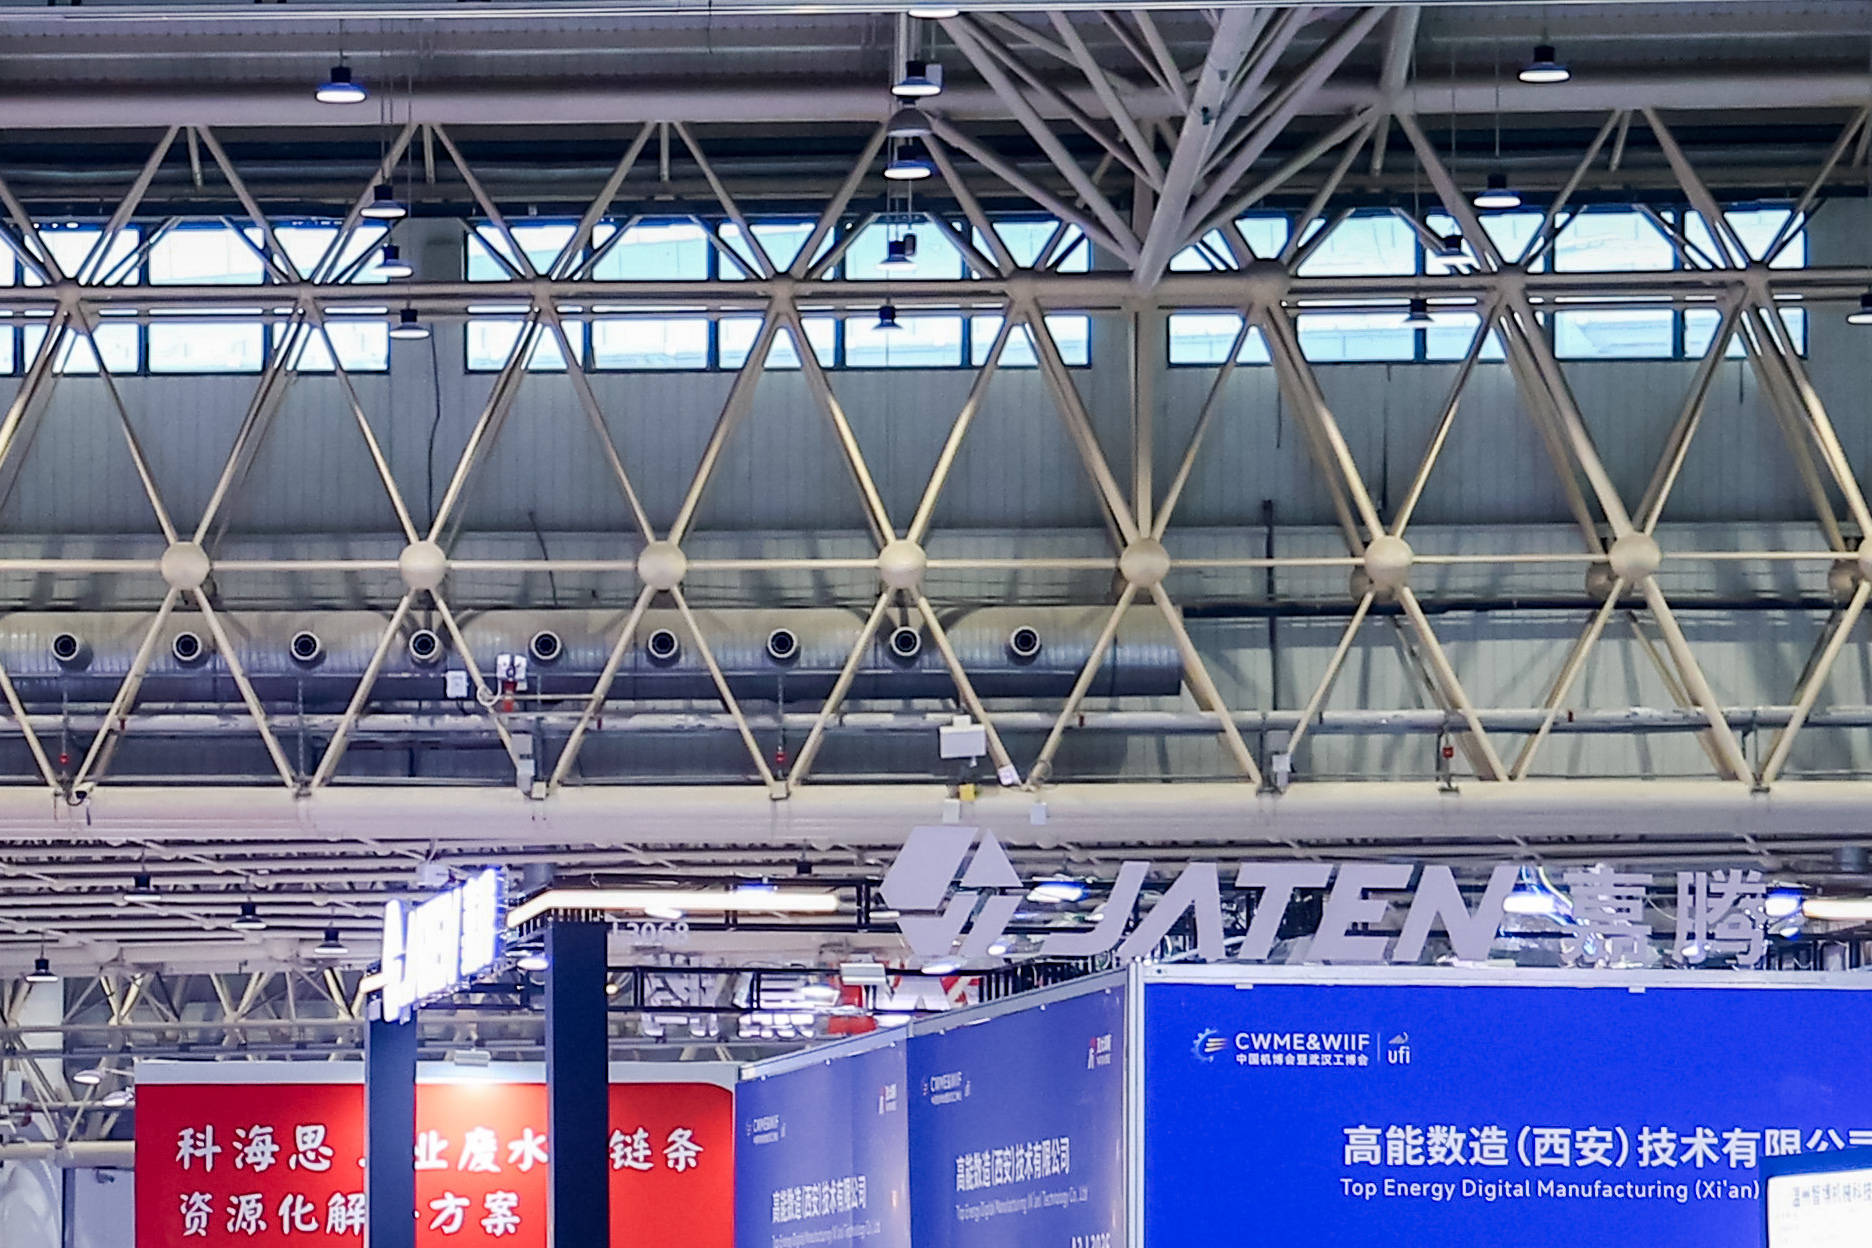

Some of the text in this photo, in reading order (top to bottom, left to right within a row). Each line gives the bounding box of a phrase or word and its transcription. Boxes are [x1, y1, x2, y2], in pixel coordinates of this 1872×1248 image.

[1037, 860, 1520, 962] JATEN
[1234, 1032, 1371, 1051] CWME&WIIF
[1387, 1046, 1412, 1065] ufi
[176, 1124, 705, 1173] 科海思业废水链条
[1340, 1178, 1760, 1203] Top Energy Digital Manufacturing (Xi'an)
[179, 1190, 521, 1237] 资源化解方案
